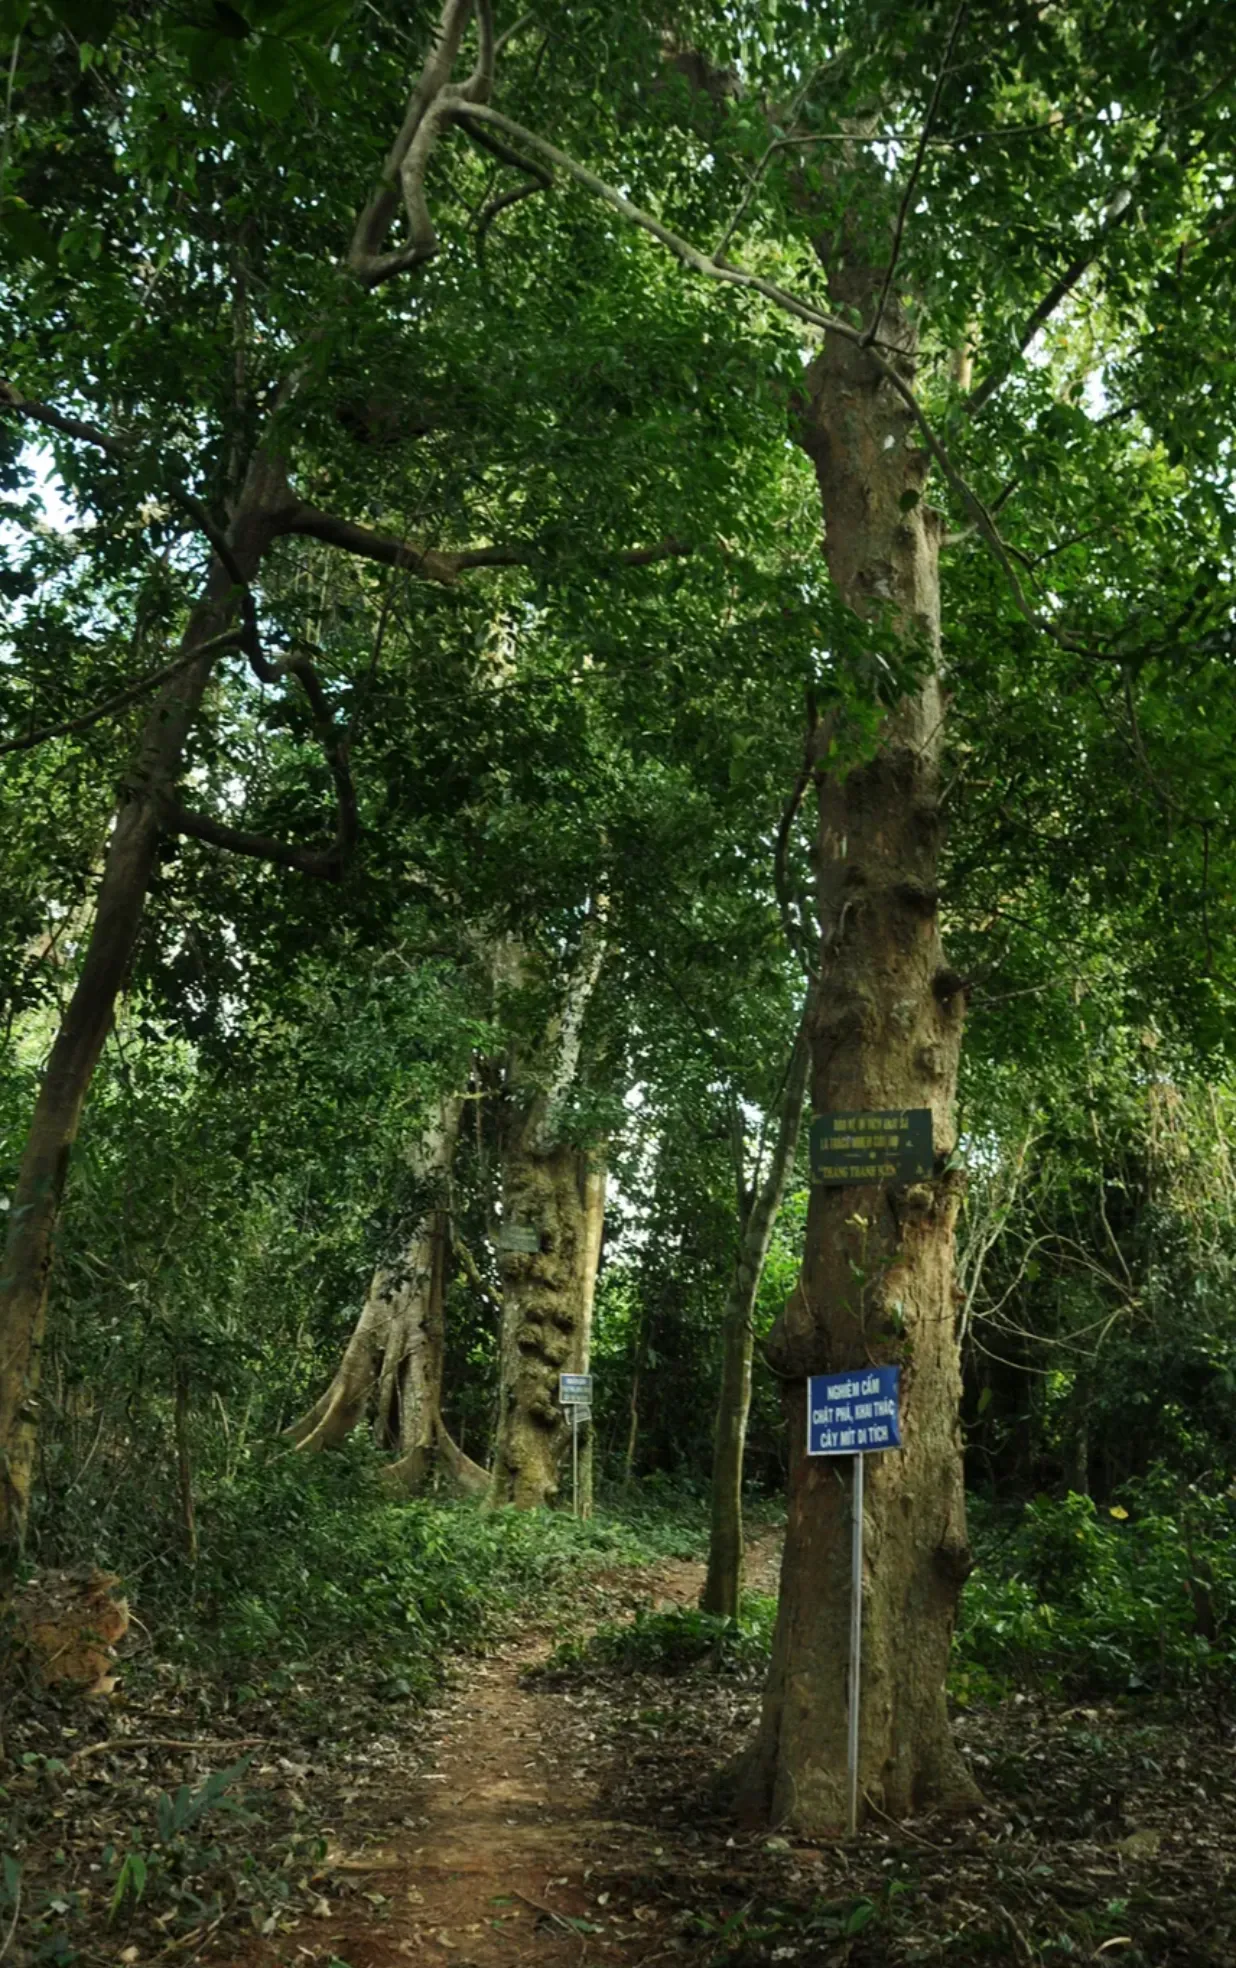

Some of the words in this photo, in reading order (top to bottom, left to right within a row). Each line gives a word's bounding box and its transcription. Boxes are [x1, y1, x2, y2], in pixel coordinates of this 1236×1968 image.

[827, 1379, 860, 1401] NGHIÊM
[861, 1373, 880, 1396] CẤM
[835, 1401, 854, 1424] PHÁ,
[855, 1403, 873, 1420] KHAI
[873, 1396, 895, 1417] THÁC
[820, 1428, 838, 1448] CÂY
[840, 1426, 856, 1446] MÍT
[857, 1428, 867, 1444] DI
[868, 1423, 889, 1442] TÍCH
